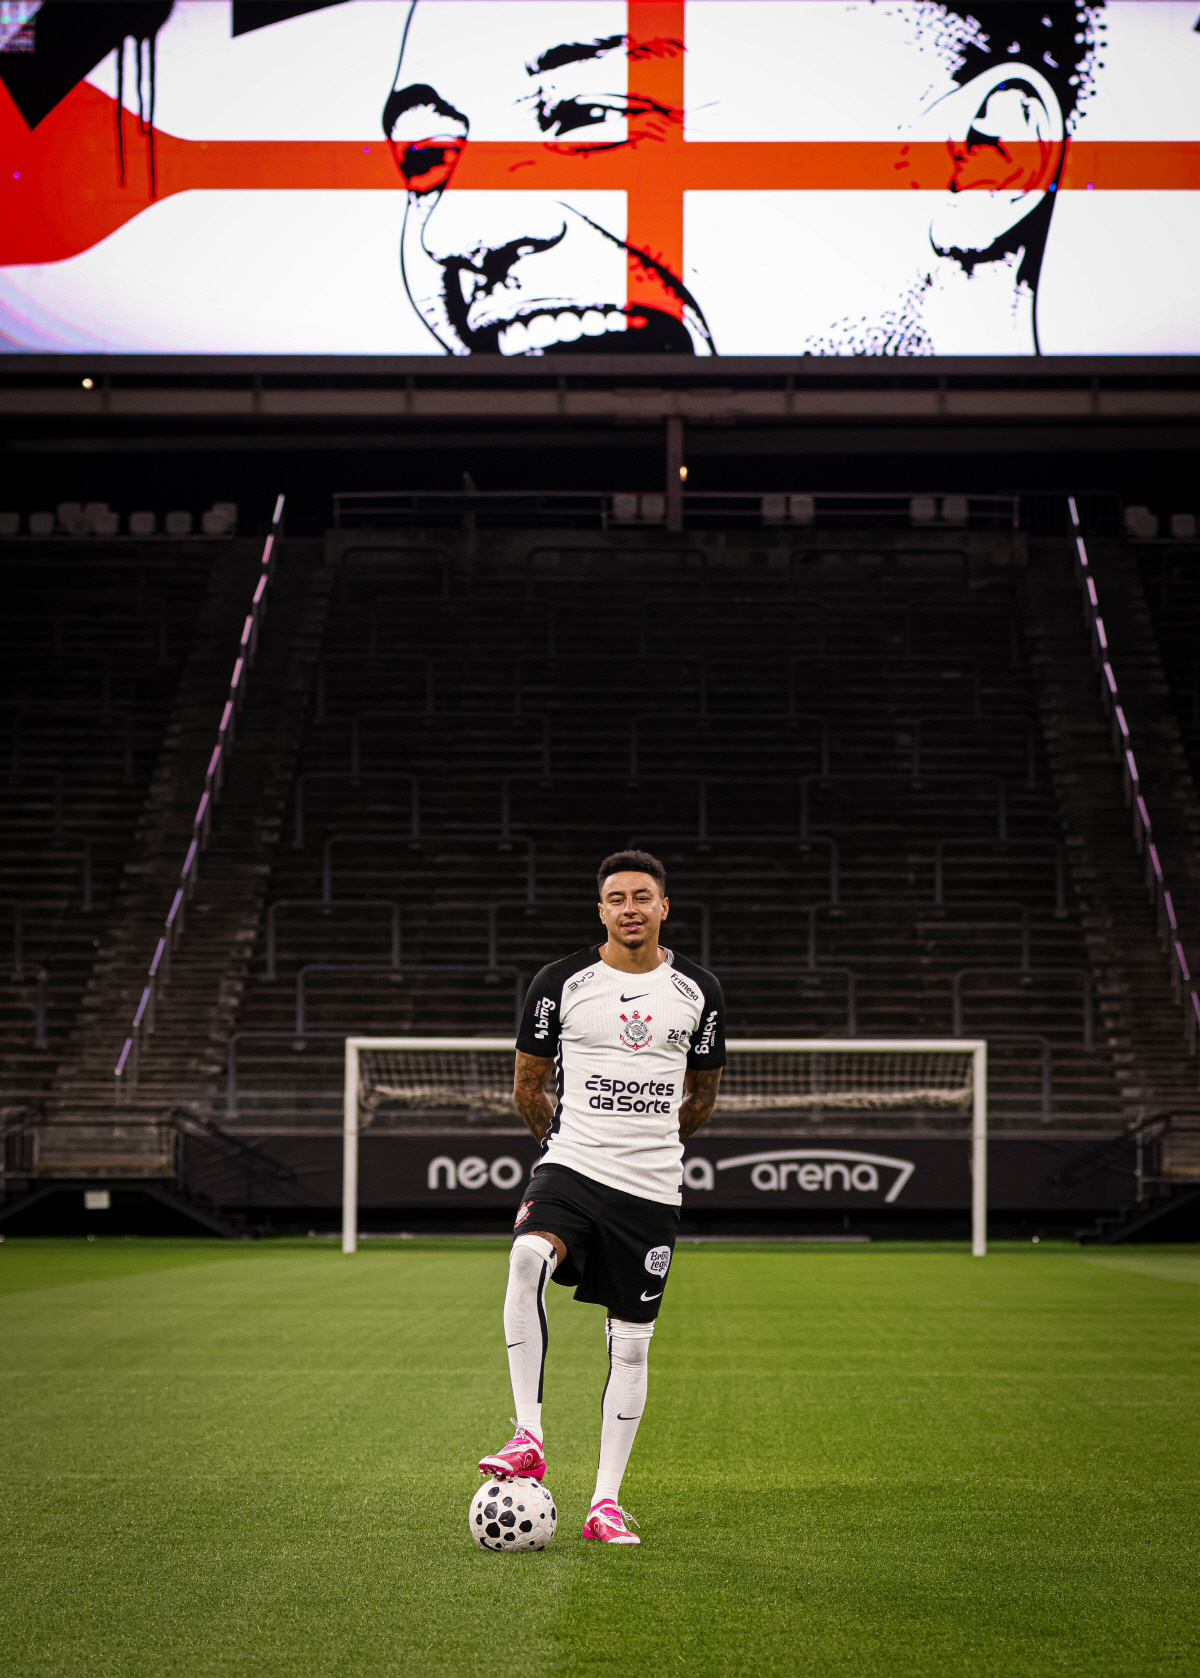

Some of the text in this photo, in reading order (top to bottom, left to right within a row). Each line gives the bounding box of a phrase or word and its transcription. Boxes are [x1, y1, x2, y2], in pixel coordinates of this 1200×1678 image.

[670, 973, 699, 1002] Frimesa
[535, 997, 556, 1029] bmg
[667, 1028, 680, 1041] Zé
[695, 1021, 717, 1055] bmg
[585, 1075, 674, 1096] Esportes
[589, 1095, 670, 1113] da Sorte
[427, 1156, 523, 1191] neo
[751, 1161, 879, 1192] arena
[650, 1251, 669, 1260] Bro
[650, 1260, 668, 1272] Leg
